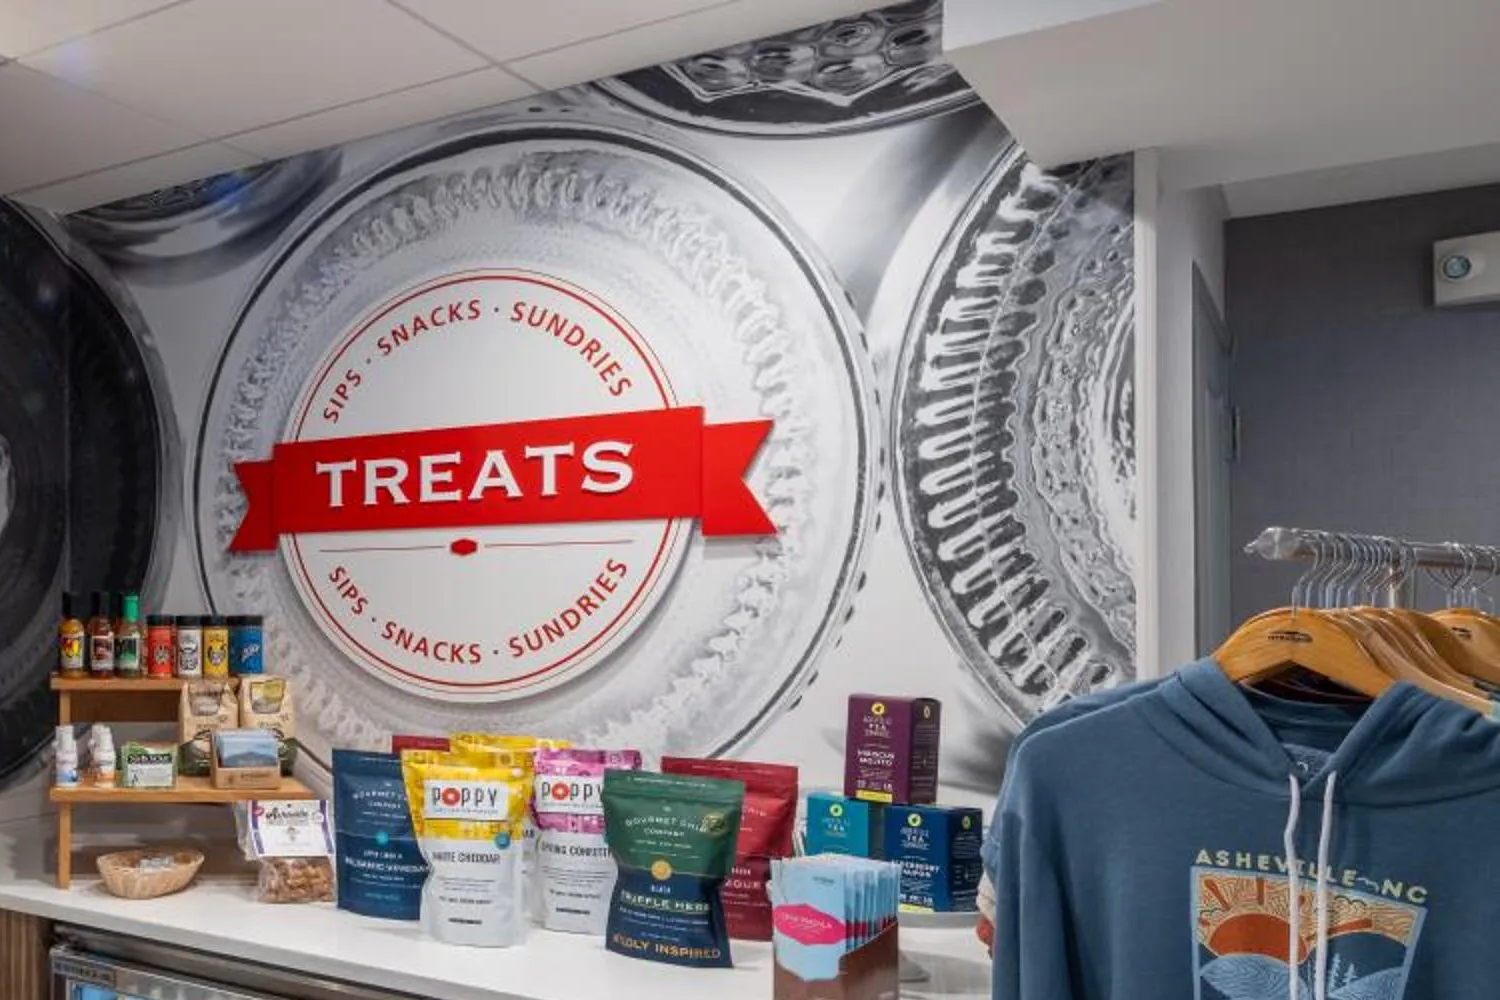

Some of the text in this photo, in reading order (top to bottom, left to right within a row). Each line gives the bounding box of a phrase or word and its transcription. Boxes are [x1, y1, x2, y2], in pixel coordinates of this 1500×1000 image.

[322, 298, 632, 424] SIPS SNACKS SUNDRIES
[315, 440, 634, 509] TREATS
[328, 558, 629, 665] SIPS SNACKS SUNDRIES
[1381, 878, 1428, 904] NC
